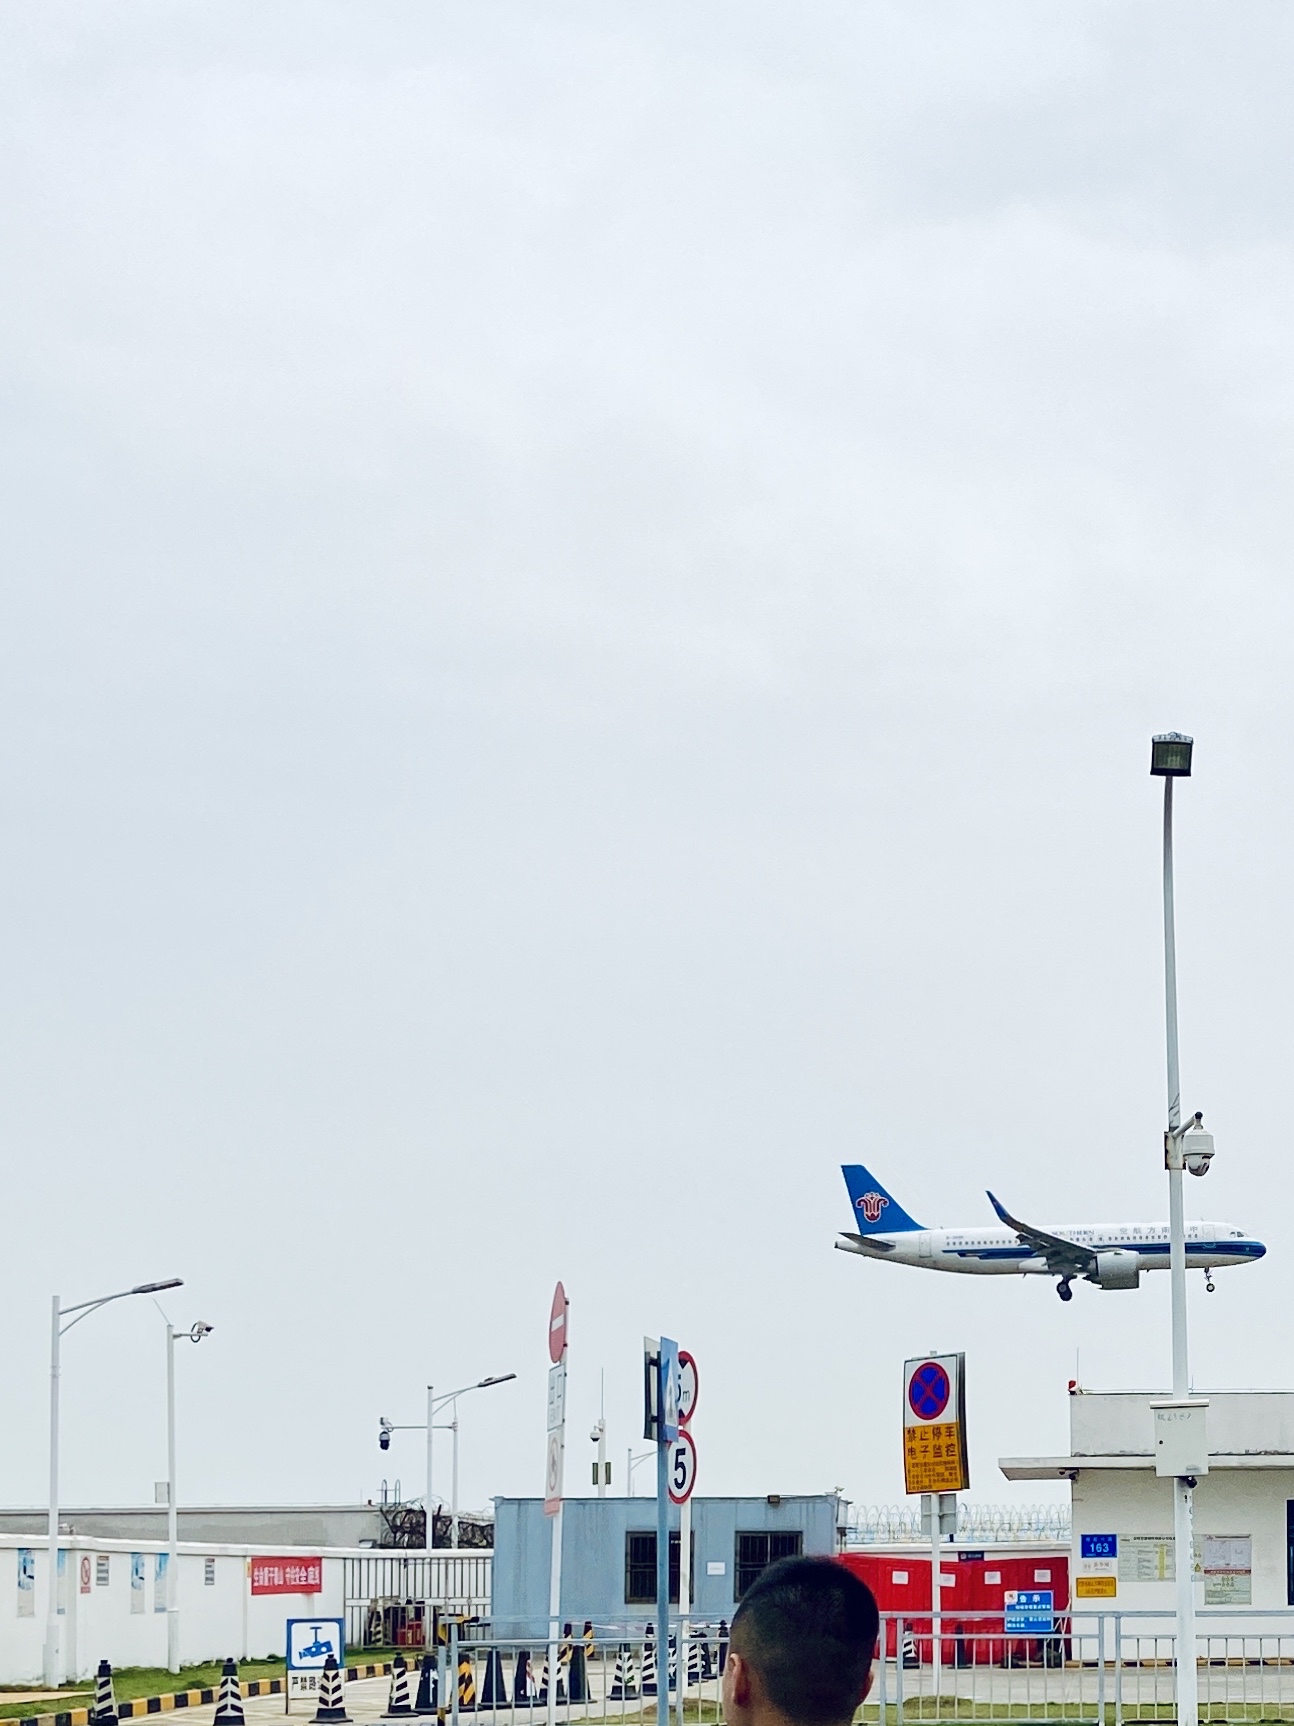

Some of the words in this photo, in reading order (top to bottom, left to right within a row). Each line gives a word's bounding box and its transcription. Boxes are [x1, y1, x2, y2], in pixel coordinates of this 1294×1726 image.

[907, 1426, 955, 1443] 禁止停车
[907, 1443, 957, 1460] 电子监控
[674, 1448, 687, 1490] 5
[1089, 1543, 1110, 1553] 163
